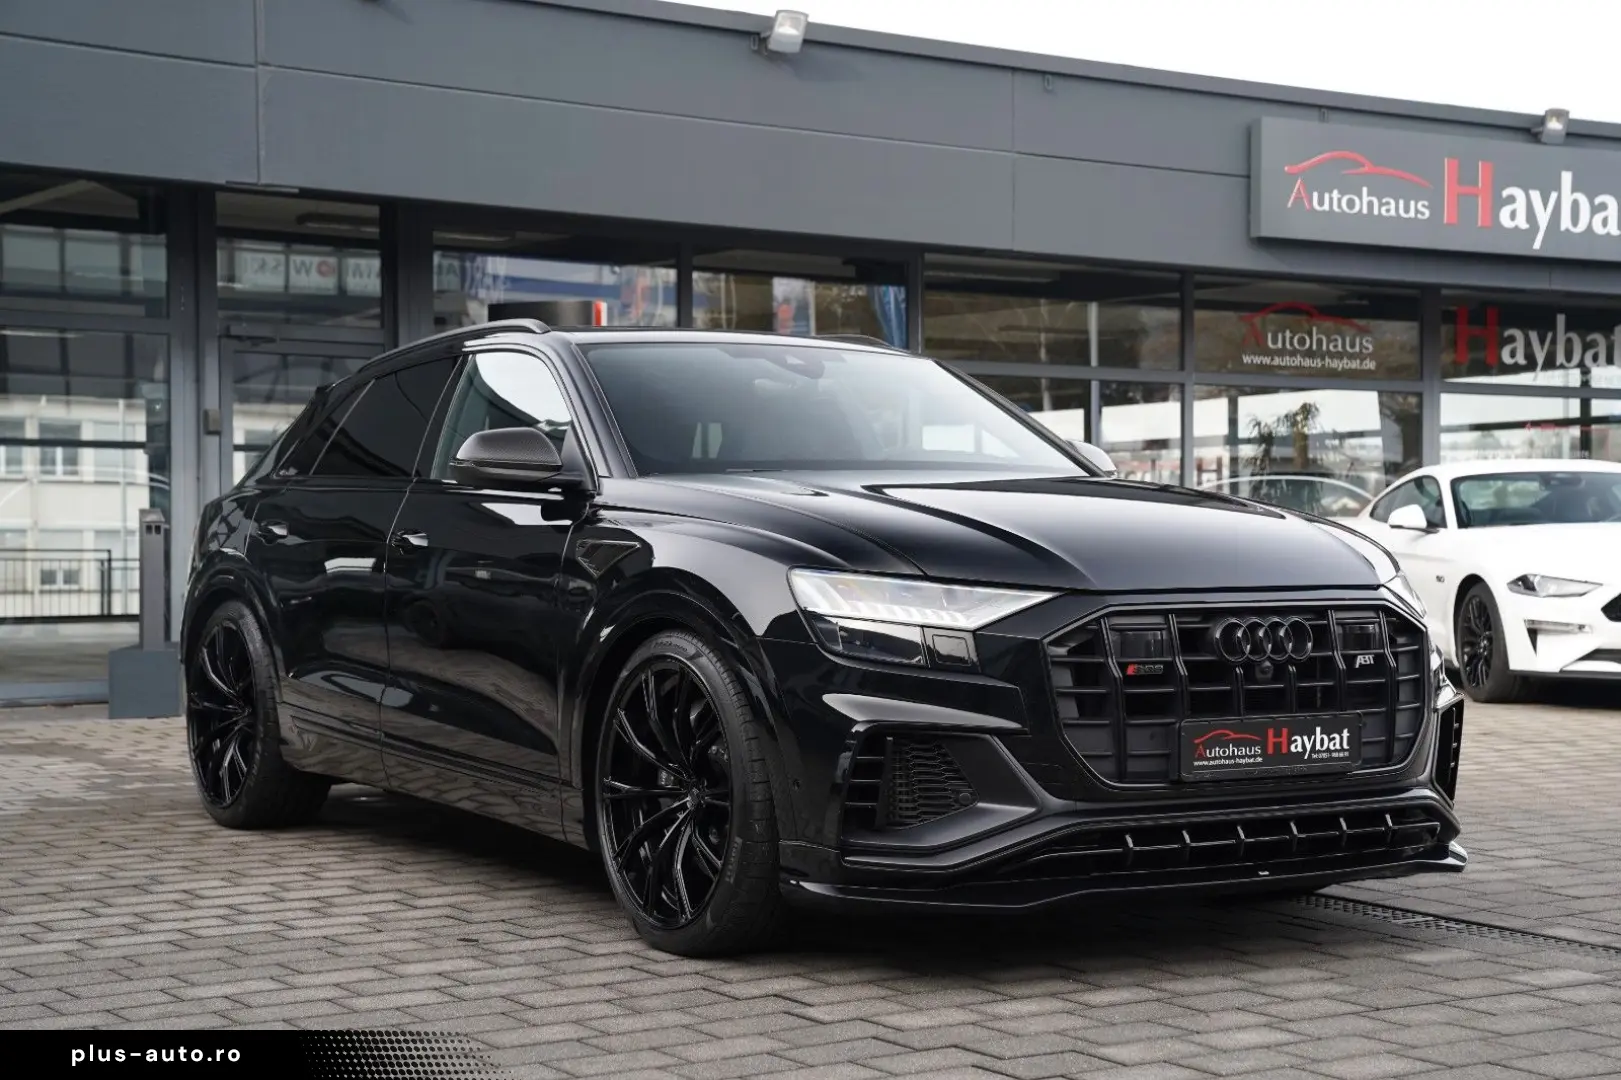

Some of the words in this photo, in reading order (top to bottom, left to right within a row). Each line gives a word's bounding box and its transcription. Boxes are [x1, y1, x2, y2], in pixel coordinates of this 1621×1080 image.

[1287, 177, 1430, 220] Autohaus
[1243, 322, 1373, 354] Autohaus
[1242, 353, 1376, 371] www.autohaus-haybat.de
[1355, 655, 1375, 668] ABT
[1195, 744, 1261, 758] Autohaus
[1267, 726, 1350, 759] Haybat
